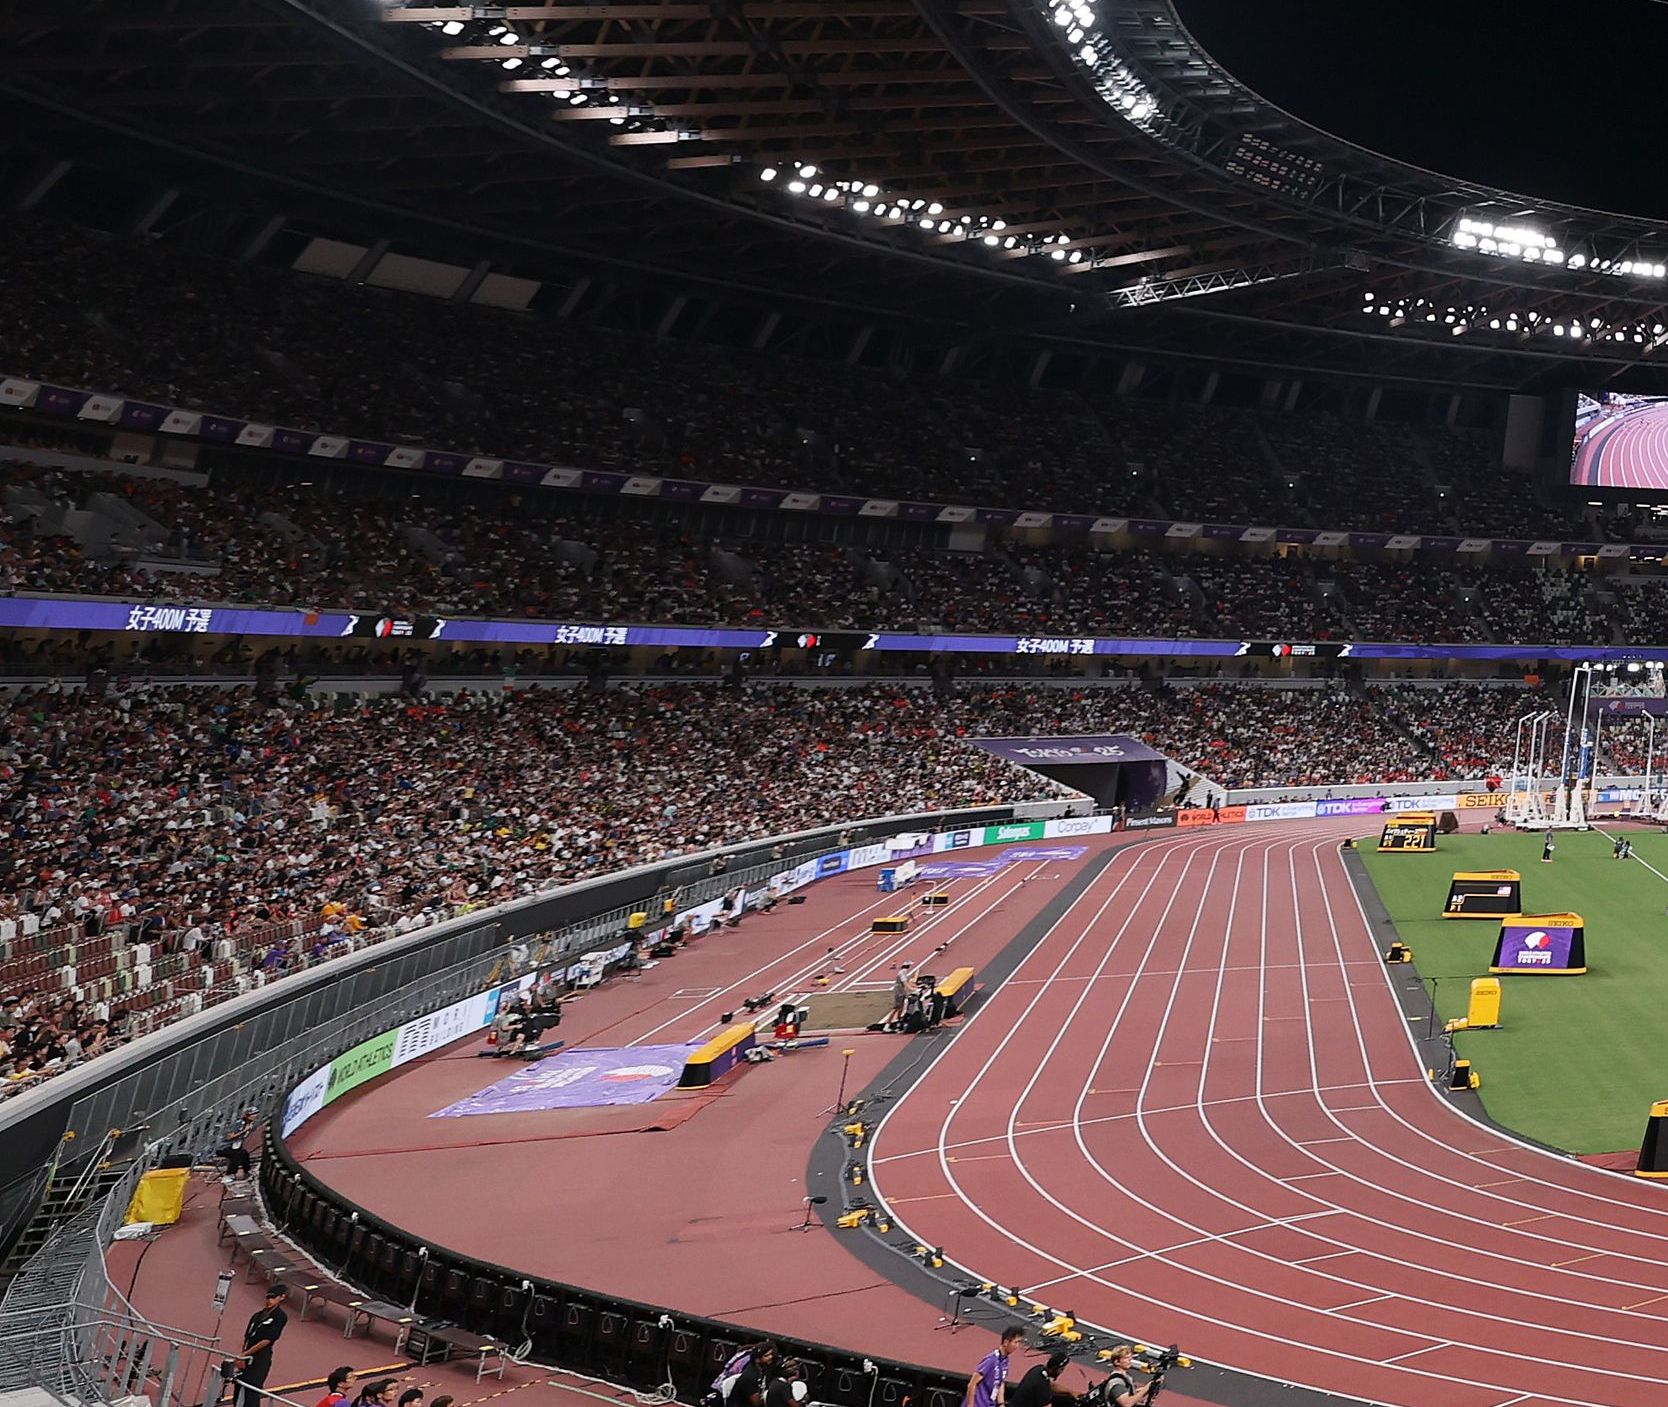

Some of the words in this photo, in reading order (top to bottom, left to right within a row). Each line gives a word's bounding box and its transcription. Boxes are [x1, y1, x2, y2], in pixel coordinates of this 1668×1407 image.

[1016, 637, 1068, 654] 女子400M
[1324, 802, 1352, 814] TDK
[1396, 799, 1420, 809] TDK
[1257, 807, 1281, 818] TDK
[1057, 819, 1093, 834] Corpay
[1403, 834, 1425, 848] 221
